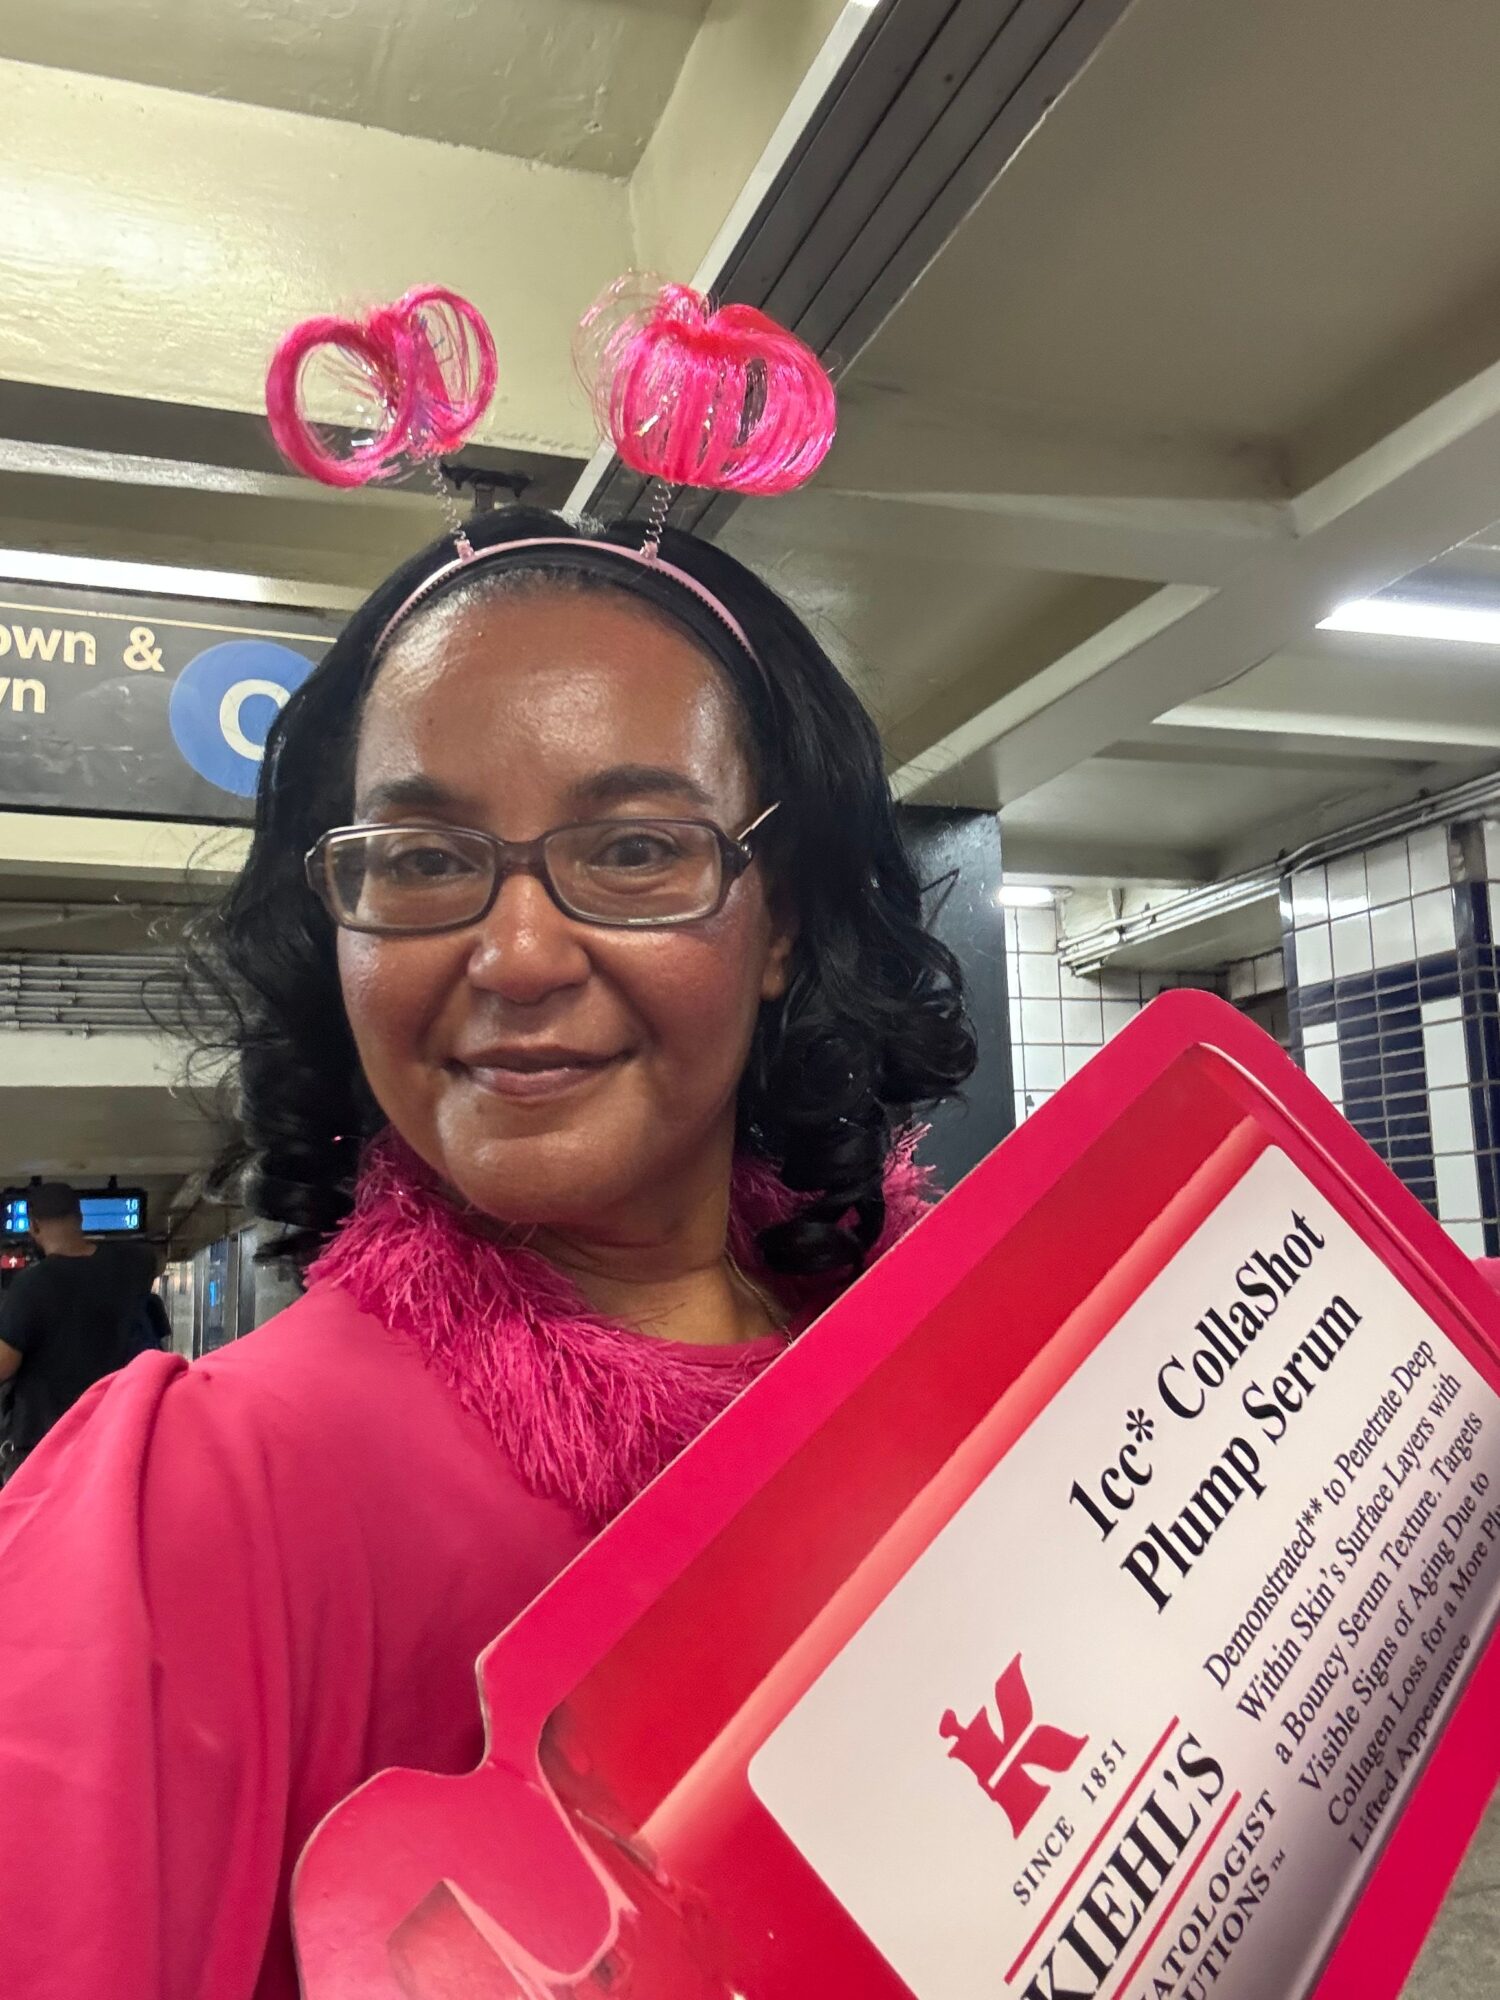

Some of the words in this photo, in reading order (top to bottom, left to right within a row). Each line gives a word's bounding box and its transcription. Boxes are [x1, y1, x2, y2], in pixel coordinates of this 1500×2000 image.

[122, 626, 166, 673] &
[1157, 1209, 1326, 1420] CollaShot
[1390, 1340, 1438, 1395] Deep
[1119, 1435, 1268, 1616] Plump
[1241, 1294, 1363, 1447] Serum
[1333, 1389, 1403, 1483] Penetrate
[1429, 1411, 1484, 1486] Targets
[1322, 1478, 1347, 1506] to
[1379, 1489, 1443, 1572] Texture.
[1236, 1636, 1303, 1727] Within
[1290, 1562, 1347, 1642] Skin's
[1335, 1484, 1395, 1568] Surface
[1382, 1415, 1435, 1489] Layers
[1427, 1372, 1463, 1418] with
[1448, 1542, 1489, 1600] More
[1298, 1704, 1361, 1791] Visible
[1351, 1635, 1400, 1707] Signs
[1394, 1599, 1416, 1638] of
[1408, 1539, 1455, 1610] Aging
[1442, 1495, 1477, 1543] Due
[1470, 1472, 1490, 1497] to
[1337, 1571, 1393, 1648] Serum
[1421, 1616, 1449, 1654] for
[1443, 1600, 1459, 1619] a
[1280, 1644, 1350, 1746] Bouncy
[1388, 1654, 1429, 1715] Loss
[1275, 1742, 1294, 1765] a
[1328, 1713, 1397, 1827] Collagen
[1348, 1768, 1399, 1855] Lifted
[1396, 1633, 1471, 1771] Appearance
[1012, 1815, 1076, 1906] SINCE
[1080, 1738, 1128, 1804] 1851
